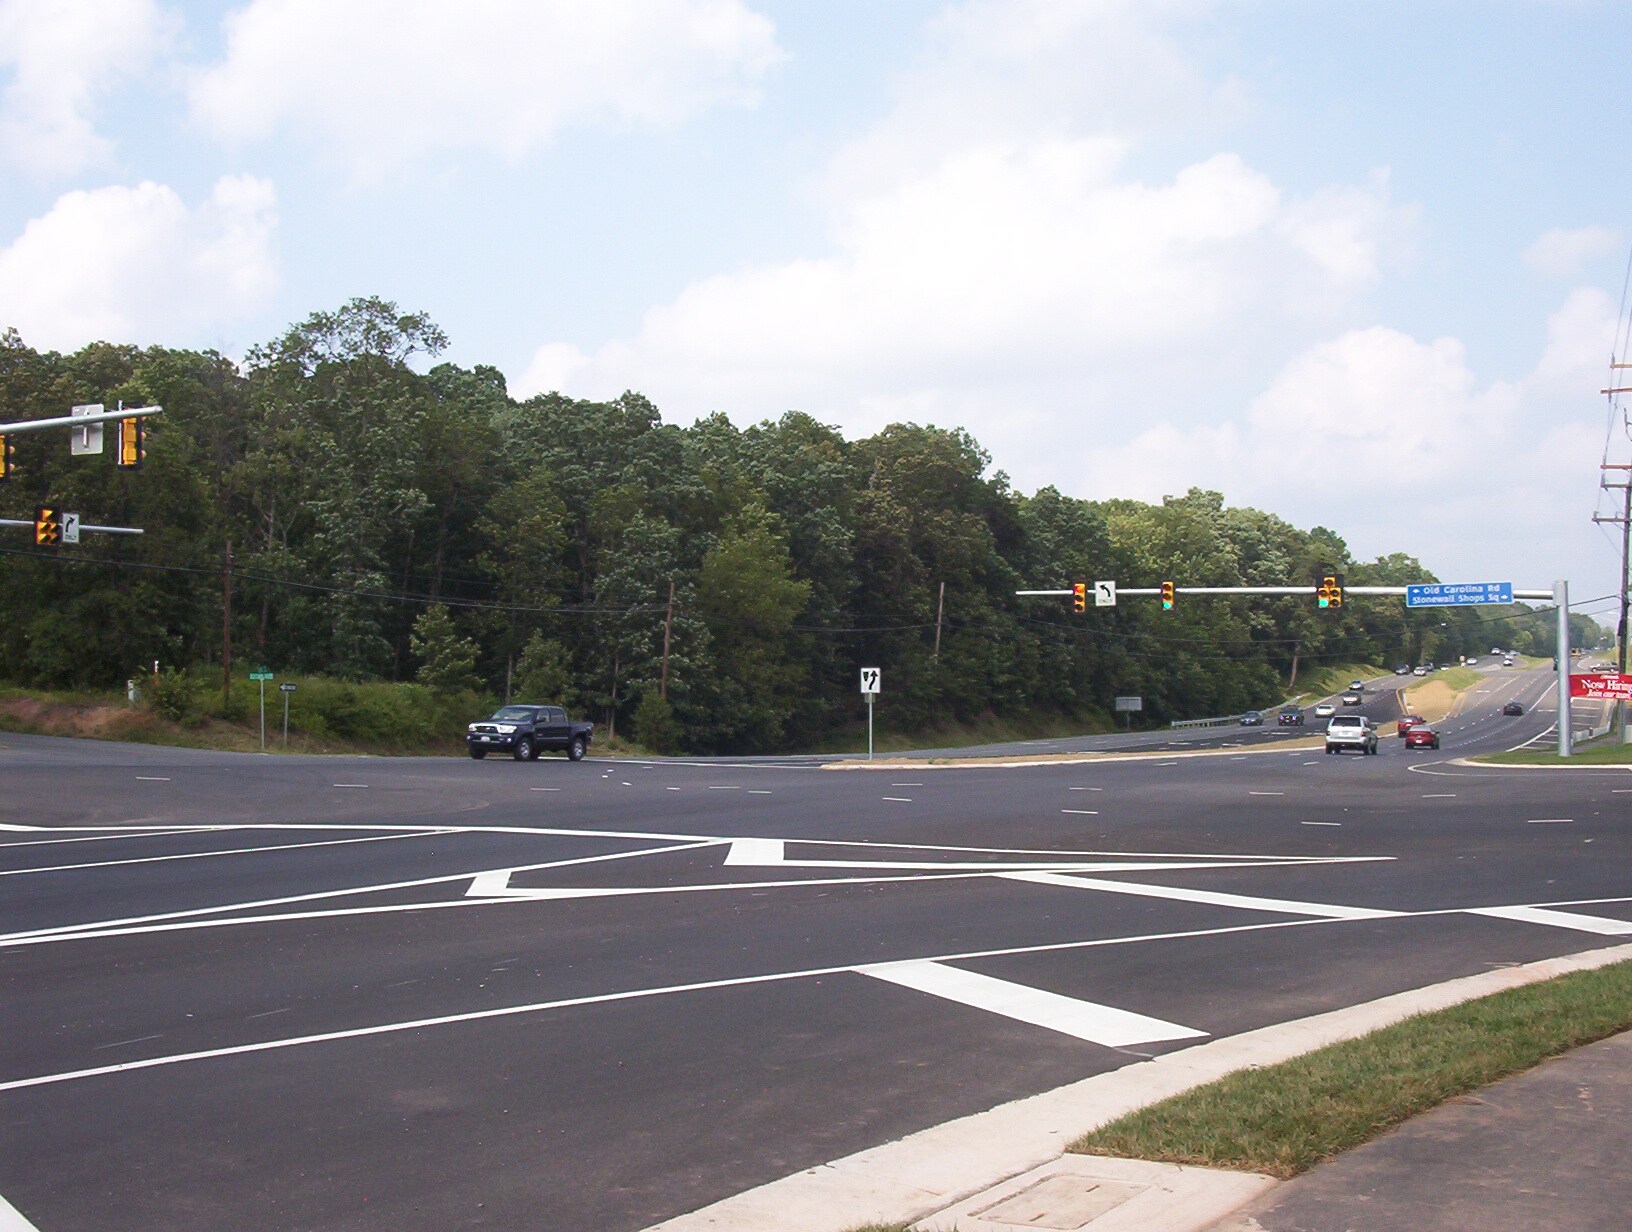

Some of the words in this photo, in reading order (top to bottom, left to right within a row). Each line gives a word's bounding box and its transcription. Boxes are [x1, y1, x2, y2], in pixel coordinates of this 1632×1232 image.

[1423, 586, 1439, 594] Old
[1443, 584, 1483, 594] Carolina
[1487, 584, 1500, 592] Rd
[1412, 596, 1455, 604] Stonewall
[1458, 594, 1485, 604] Shops
[1488, 593, 1500, 602] Sq
[1581, 679, 1606, 689] Now
